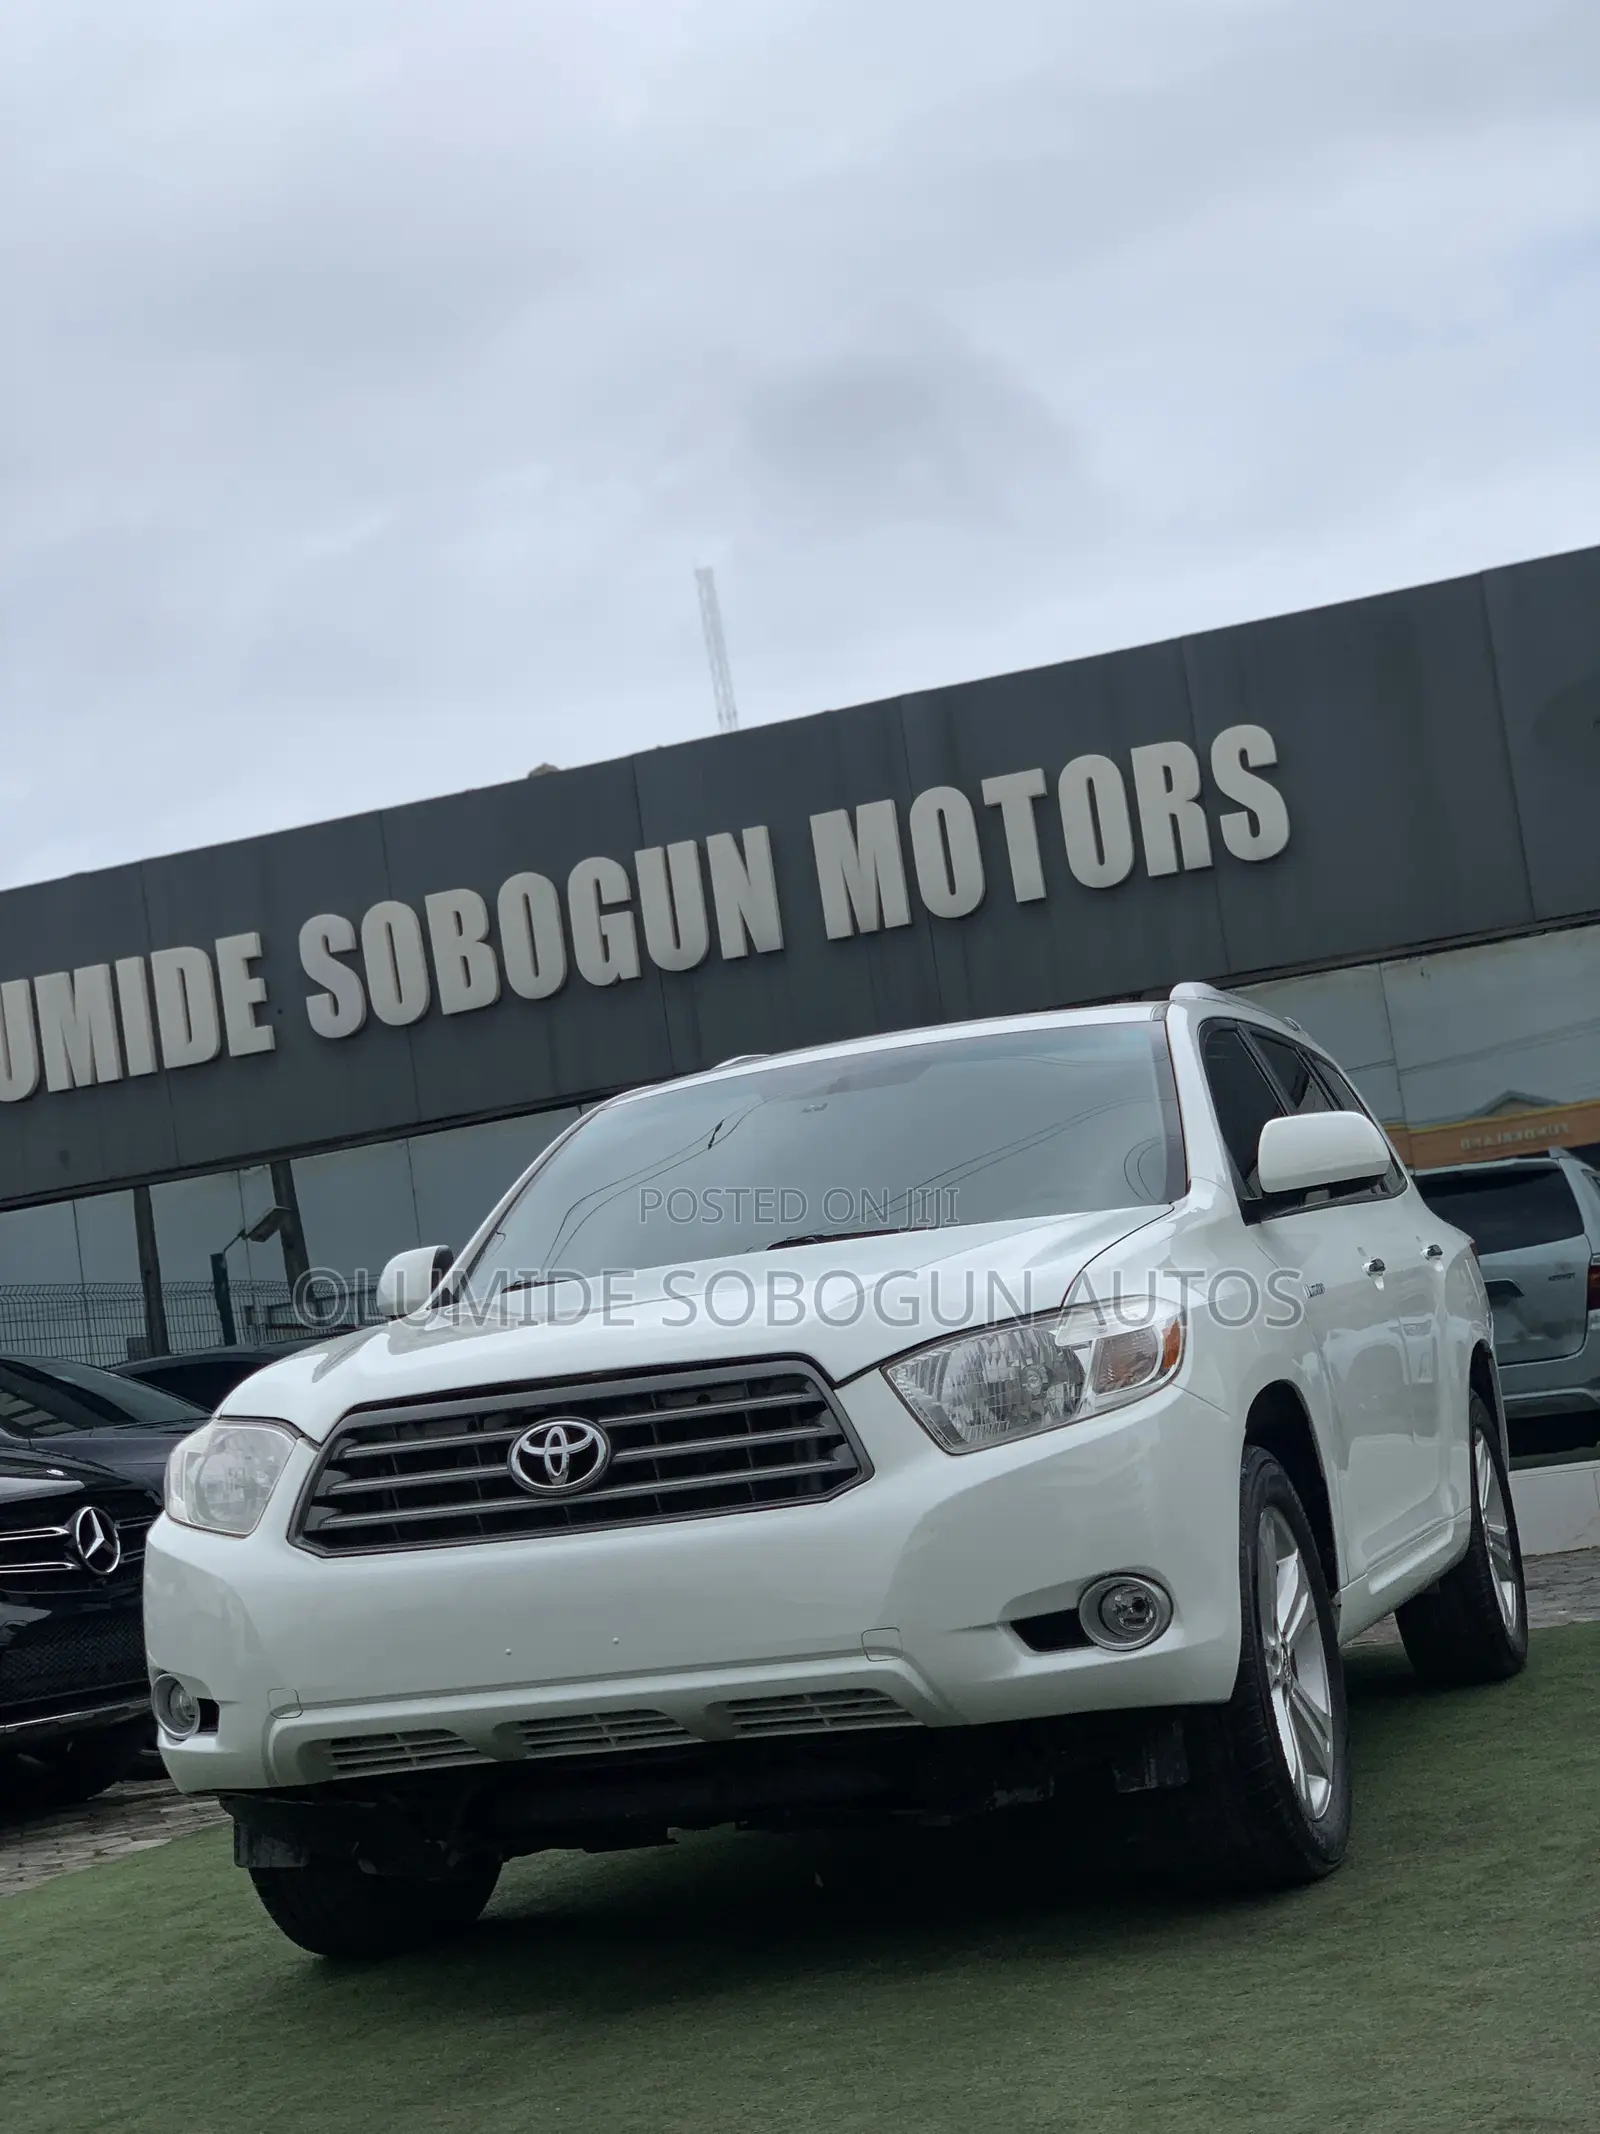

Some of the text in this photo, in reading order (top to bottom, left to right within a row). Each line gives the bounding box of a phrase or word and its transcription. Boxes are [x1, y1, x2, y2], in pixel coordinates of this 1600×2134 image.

[0, 724, 1291, 1102] UMIDE SOBOGUN MOTORS
